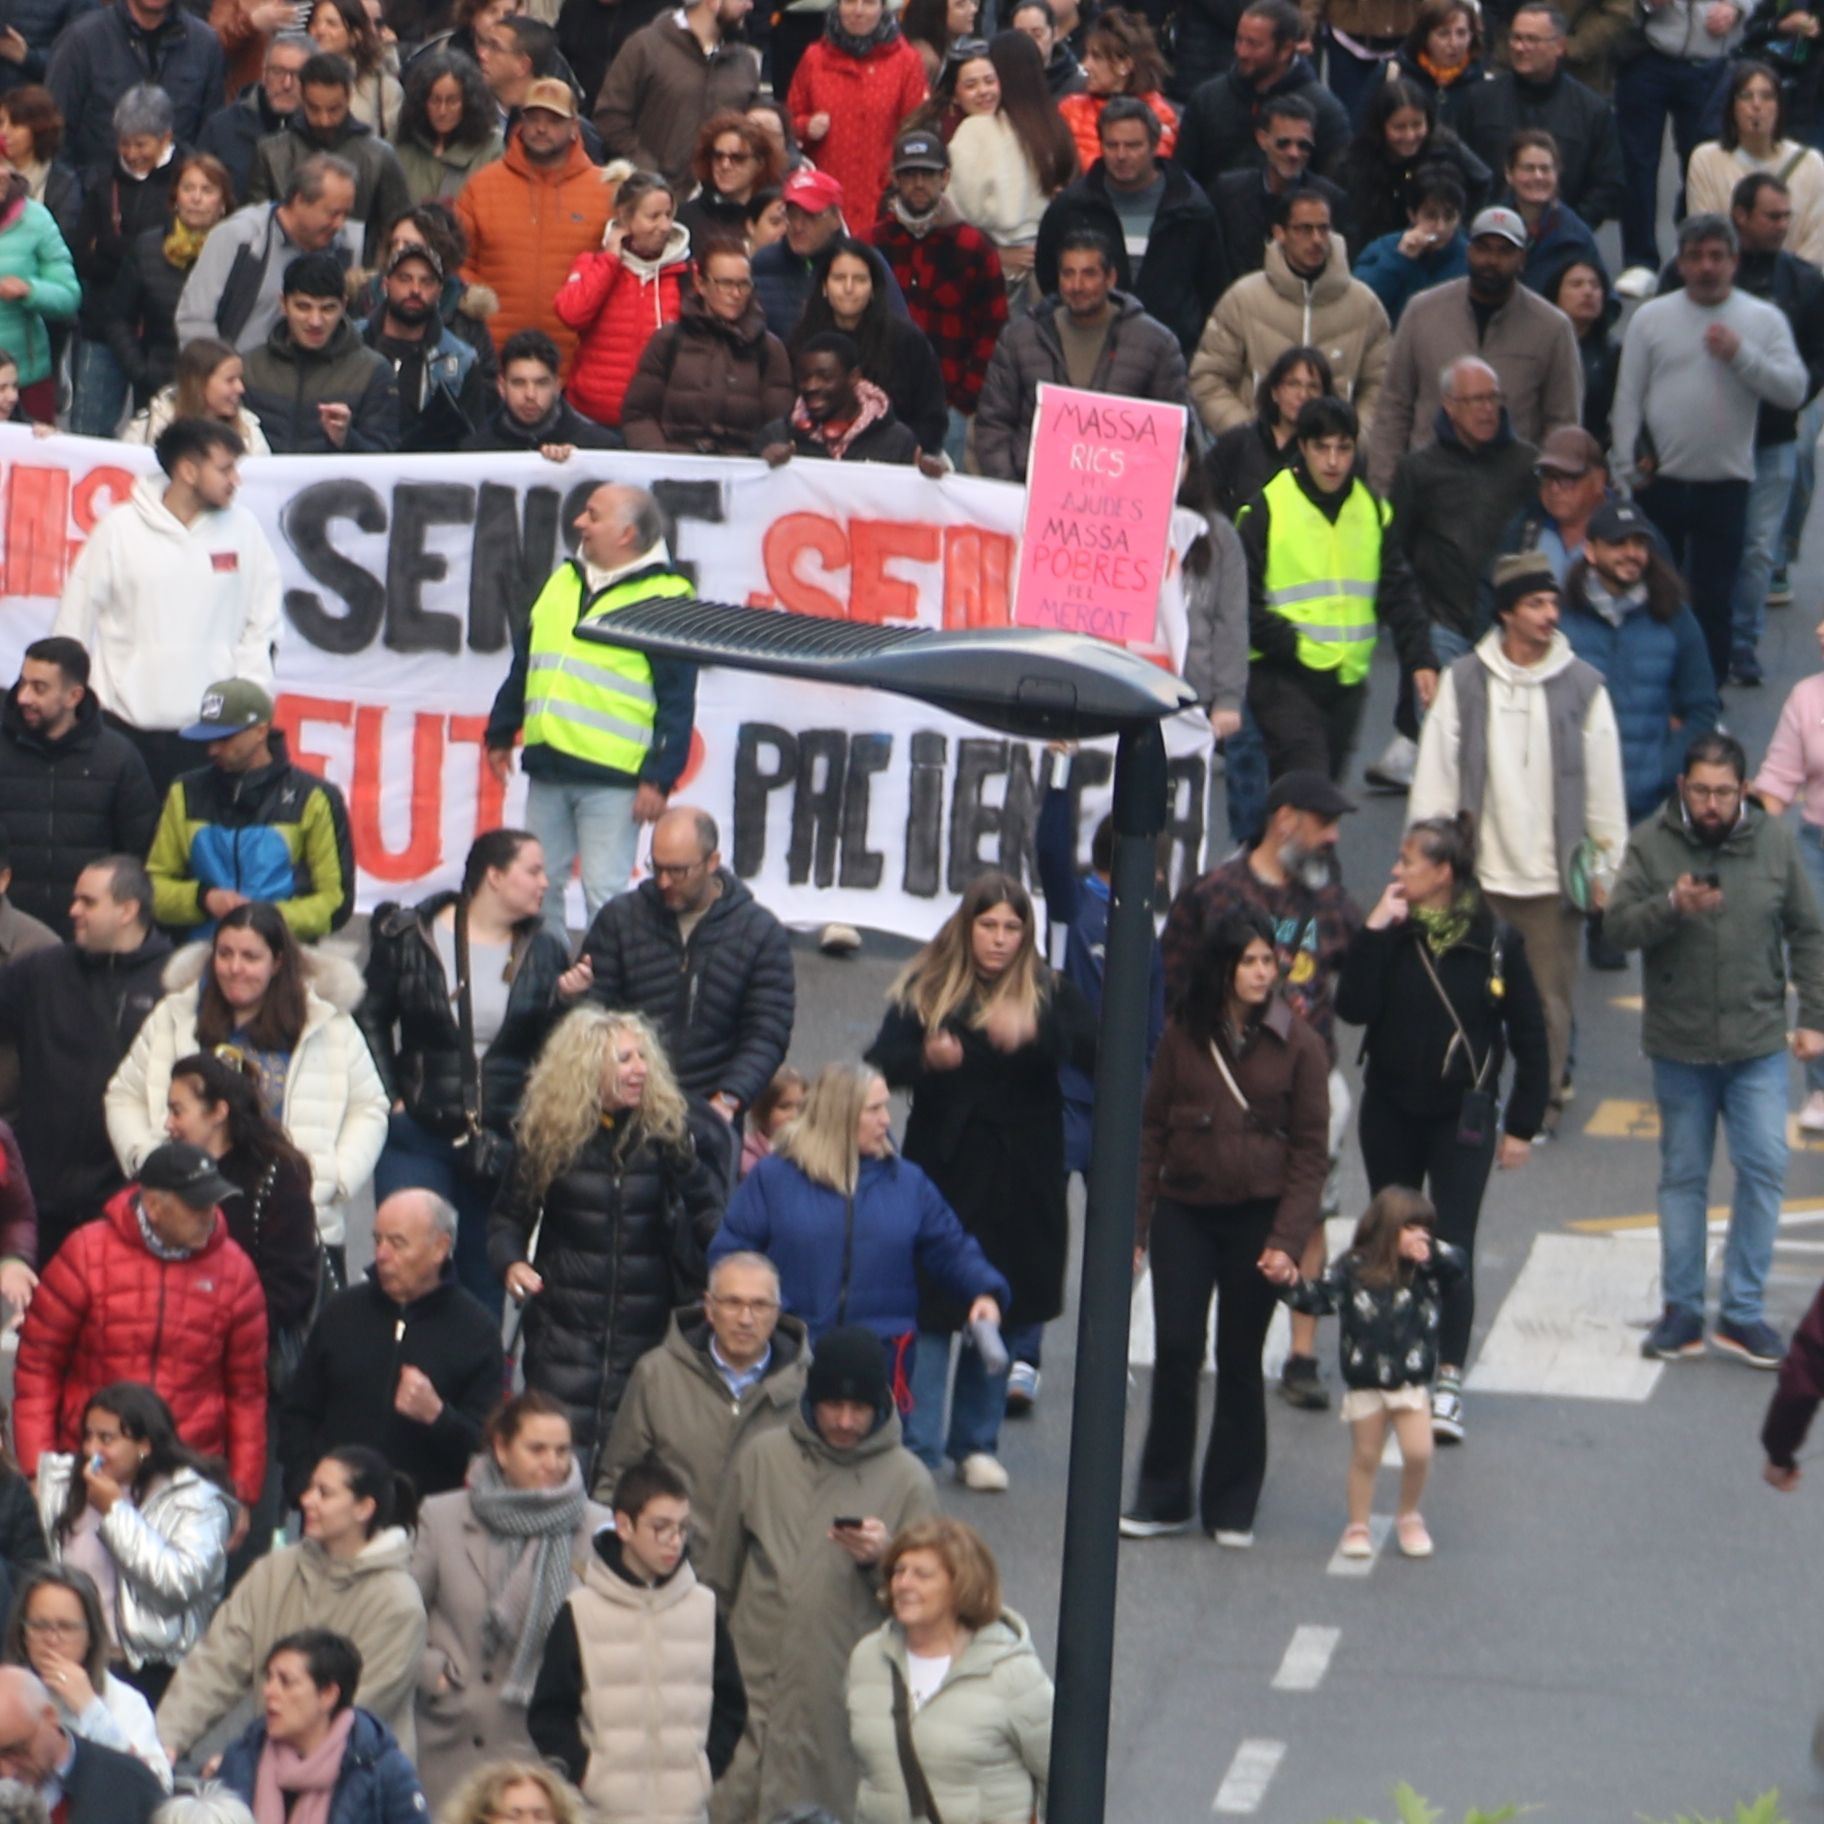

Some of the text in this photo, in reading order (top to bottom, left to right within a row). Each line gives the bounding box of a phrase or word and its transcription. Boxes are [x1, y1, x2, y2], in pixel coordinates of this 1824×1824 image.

[1052, 402, 1159, 446] MASSA
[1069, 442, 1126, 478] RICS
[1060, 490, 1144, 522] AJUDES
[1041, 516, 1130, 553] MASSA
[1032, 543, 1151, 593] POBRES
[1035, 597, 1133, 637] MERCAT
